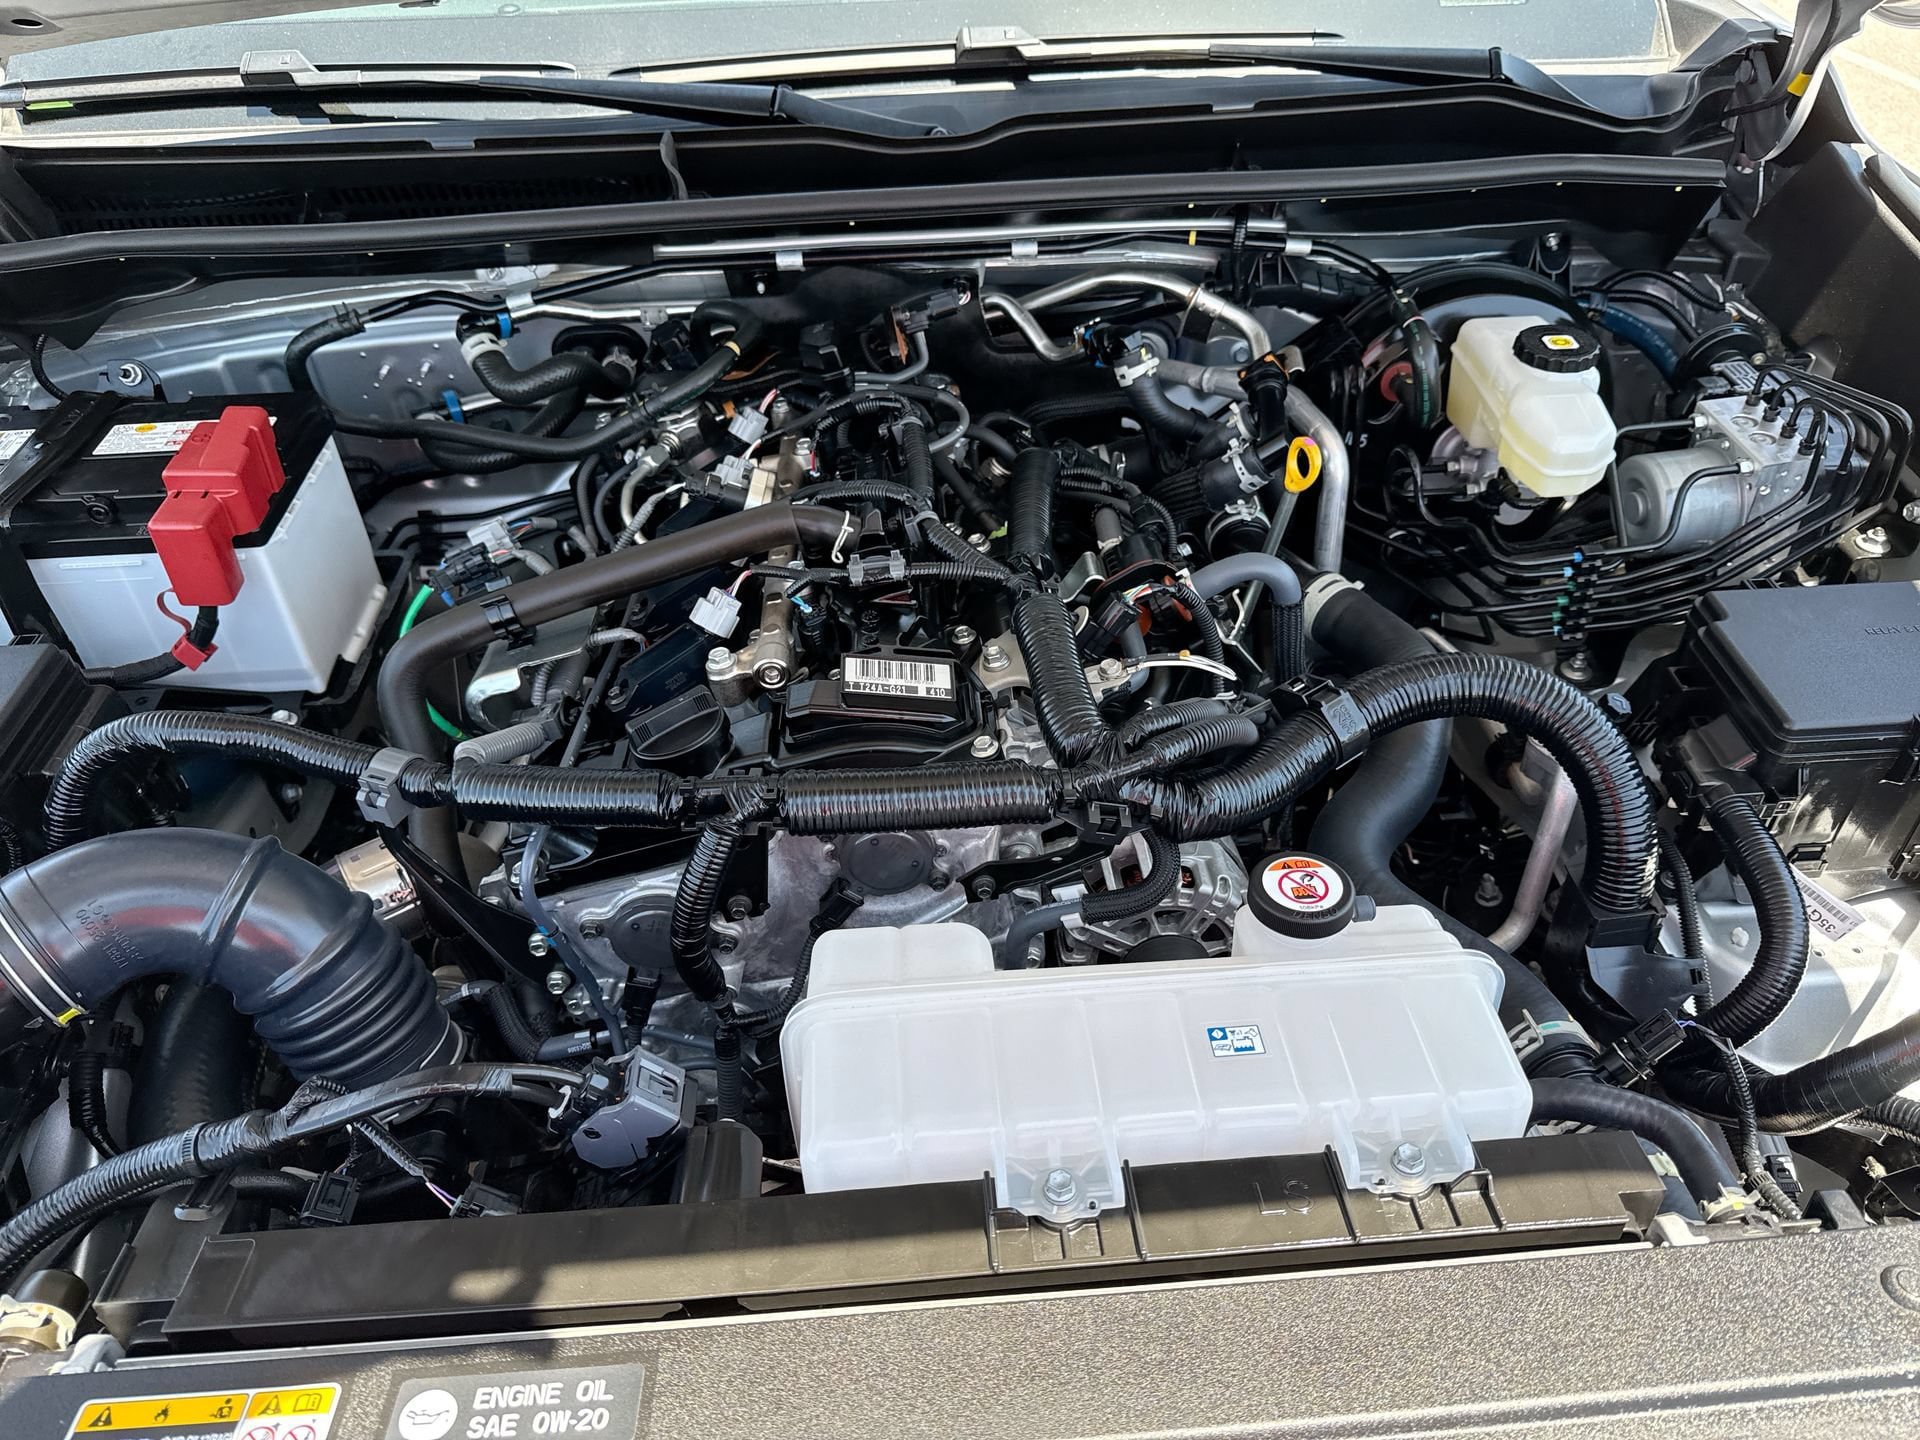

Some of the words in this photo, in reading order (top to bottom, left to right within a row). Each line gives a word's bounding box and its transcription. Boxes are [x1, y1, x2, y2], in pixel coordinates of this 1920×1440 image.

[860, 682, 906, 695] T24A-G21
[929, 688, 946, 697] 410
[1253, 1180, 1314, 1216] LS
[472, 1382, 564, 1410] ENGINE
[575, 1379, 615, 1402] OIL
[466, 1413, 521, 1439] SAE
[532, 1407, 610, 1435] 0W-20
